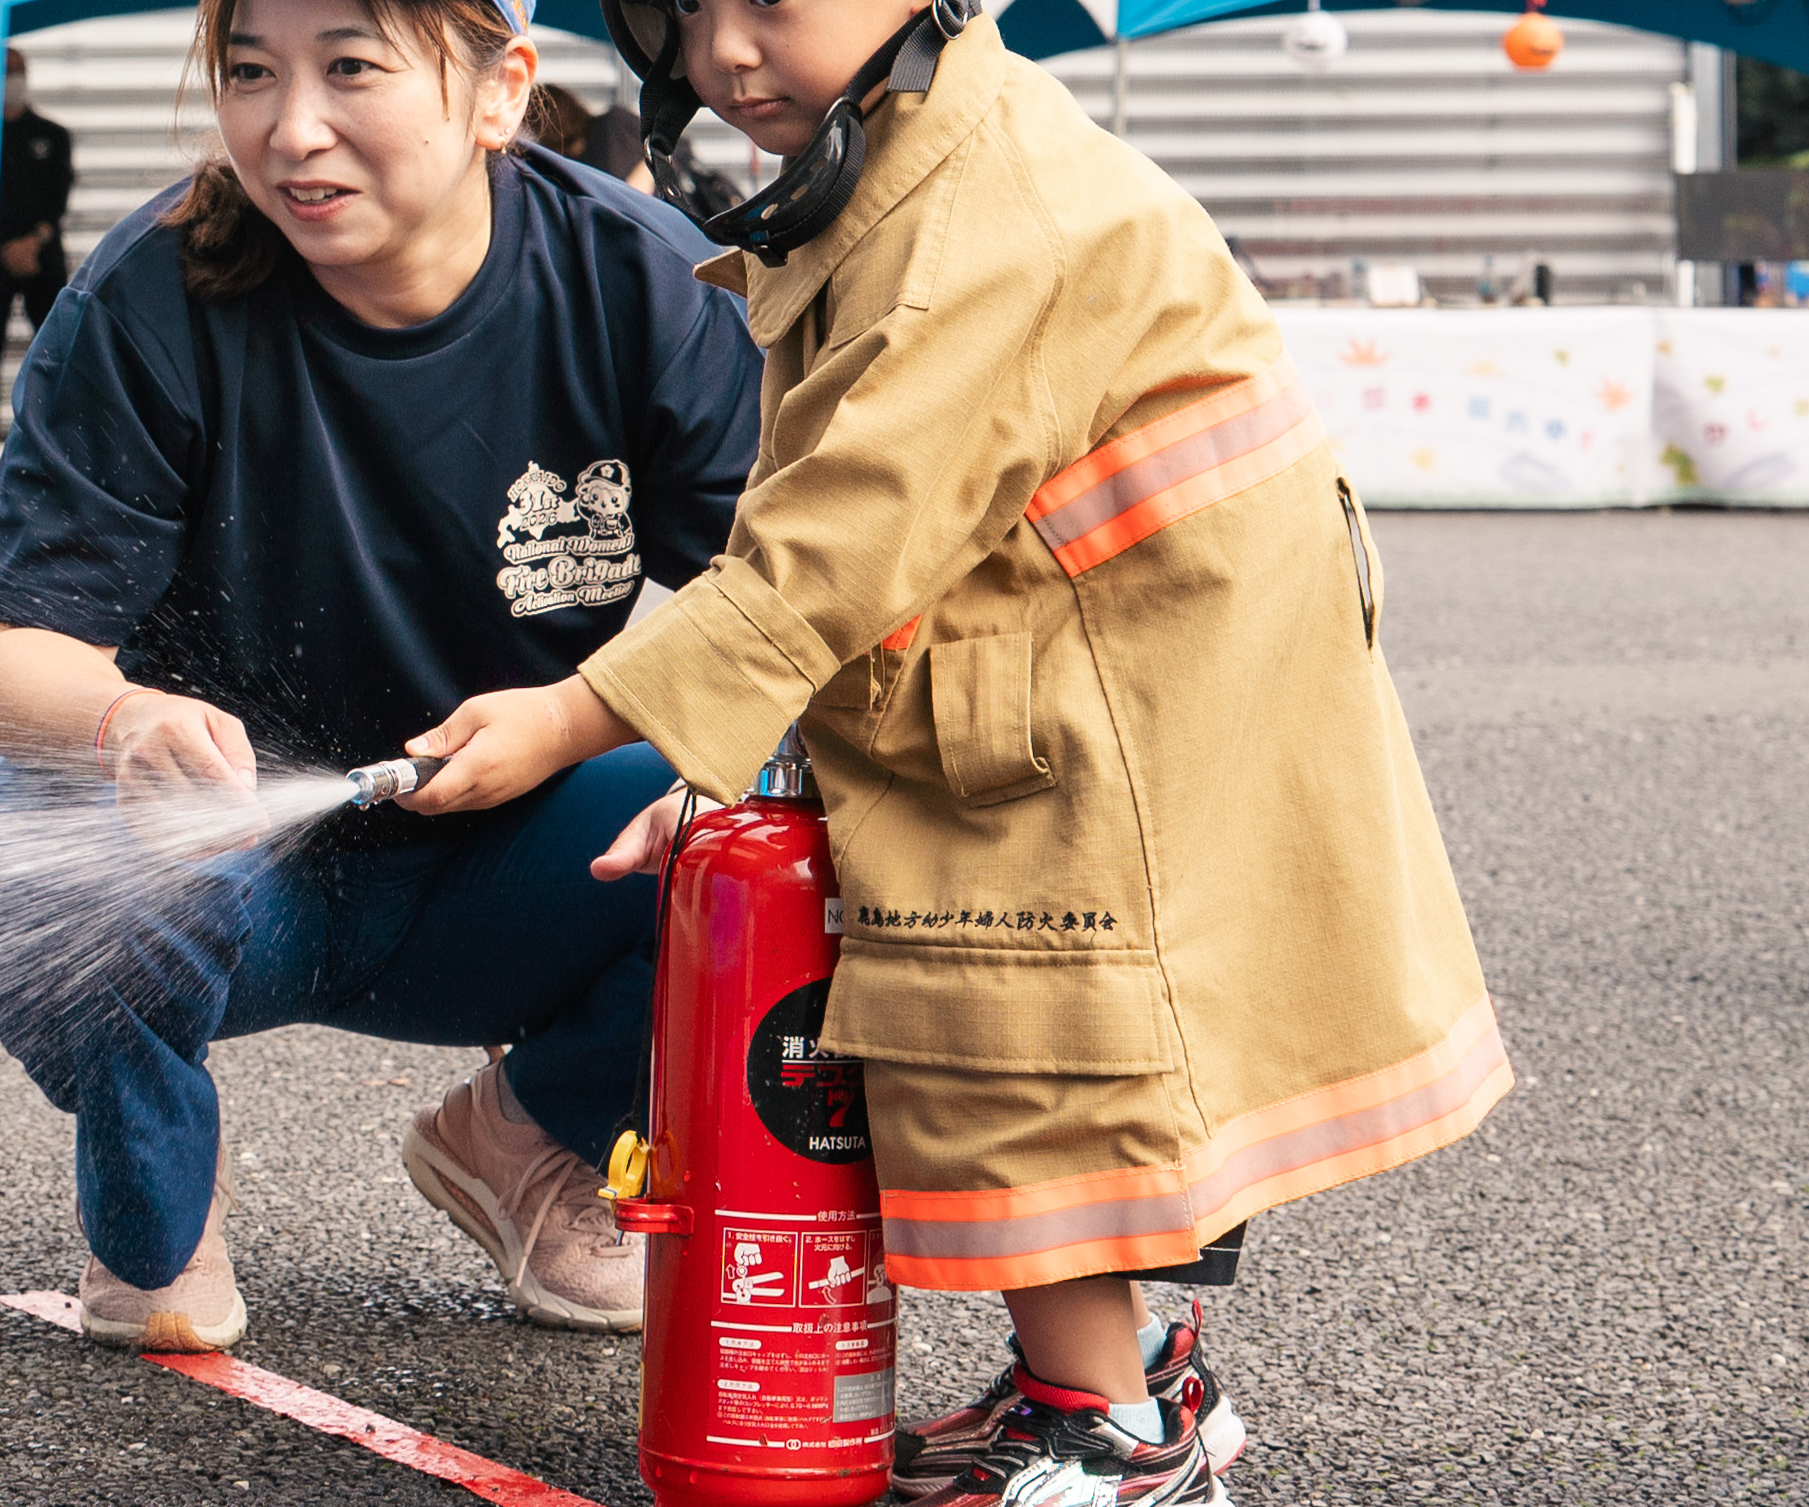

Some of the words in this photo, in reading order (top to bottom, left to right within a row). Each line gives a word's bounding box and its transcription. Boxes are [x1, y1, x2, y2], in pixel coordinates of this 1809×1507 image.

[507, 469, 567, 503] HOKKAIDO
[519, 490, 560, 516] 31st
[504, 537, 568, 564] National
[497, 565, 548, 599] Fire
[511, 589, 579, 617] Activation
[809, 1135, 866, 1150] HATSUTA
[817, 1209, 856, 1222] 使用方法
[792, 1320, 868, 1334] 取扱上の注意事項
